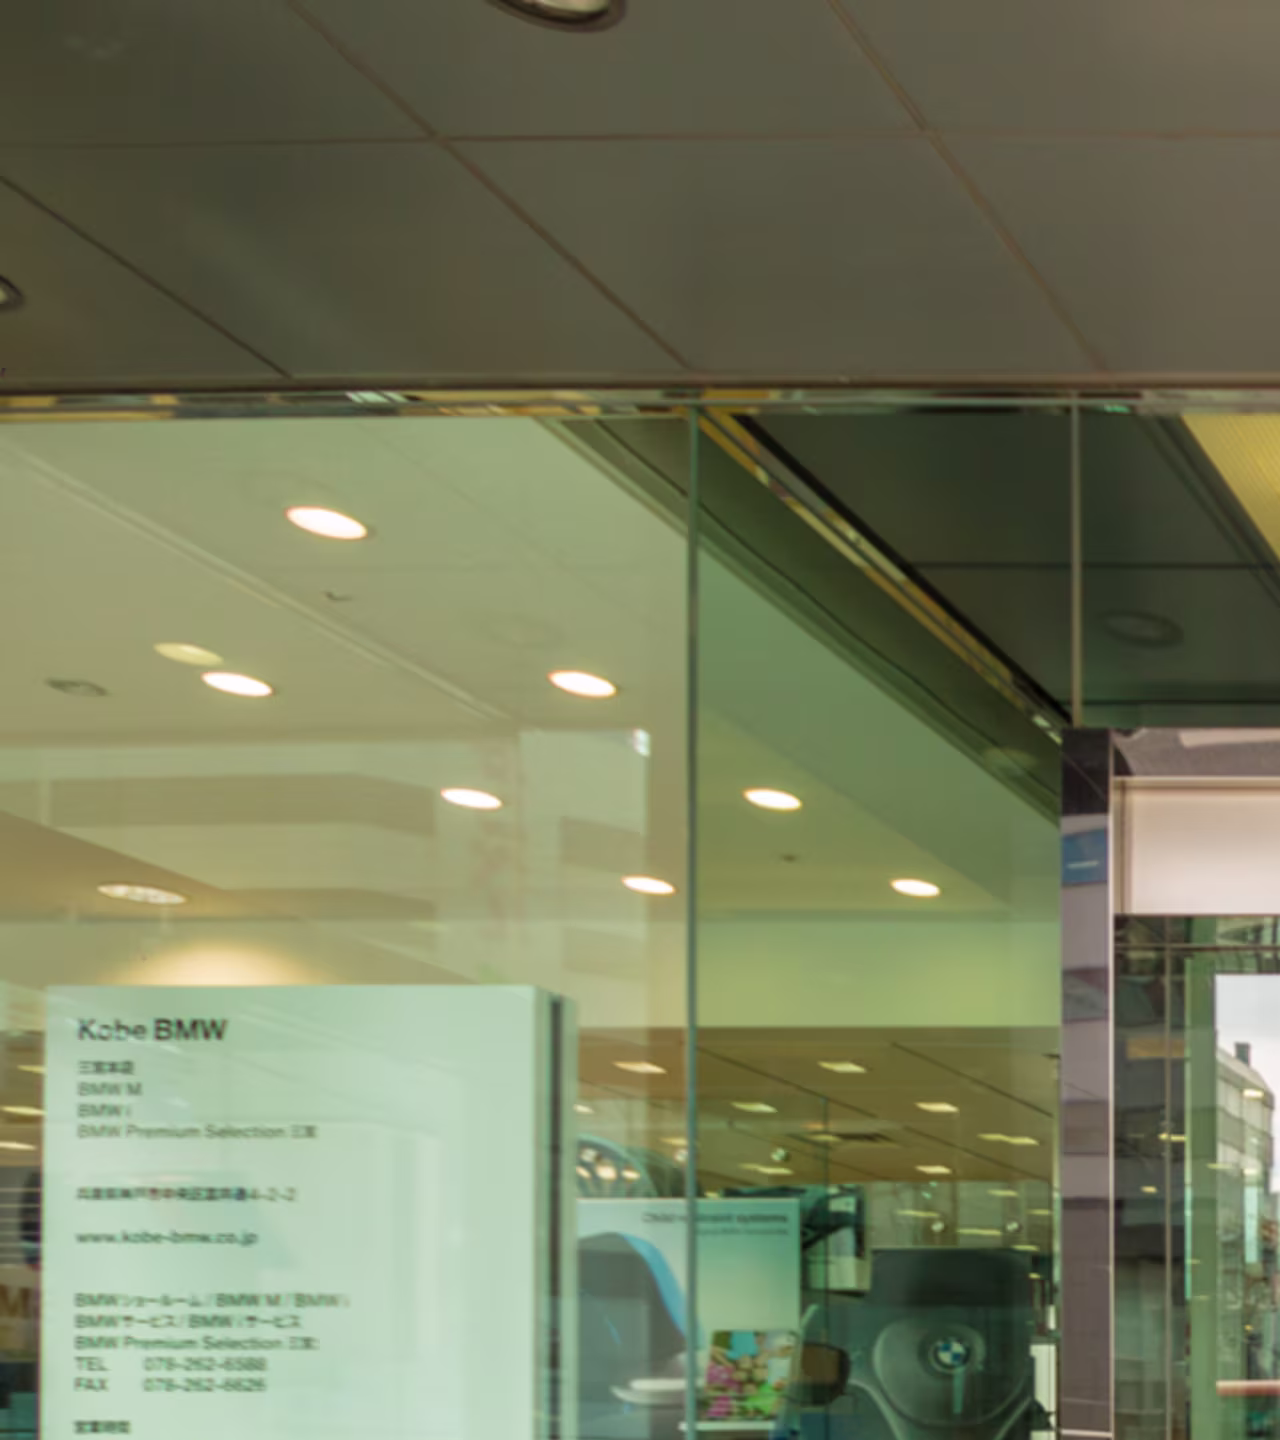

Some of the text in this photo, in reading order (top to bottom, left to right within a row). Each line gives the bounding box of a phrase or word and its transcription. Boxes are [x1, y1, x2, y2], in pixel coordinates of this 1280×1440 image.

[77, 1017, 228, 1042] Kobe BMW
[77, 1081, 122, 1097] BMW
[77, 1103, 122, 1119] BMW
[77, 1124, 122, 1140] BMW
[126, 1124, 201, 1140] Premium
[204, 1124, 286, 1140] Selection
[74, 1356, 109, 1372] TEL
[74, 1377, 108, 1393] FAX
